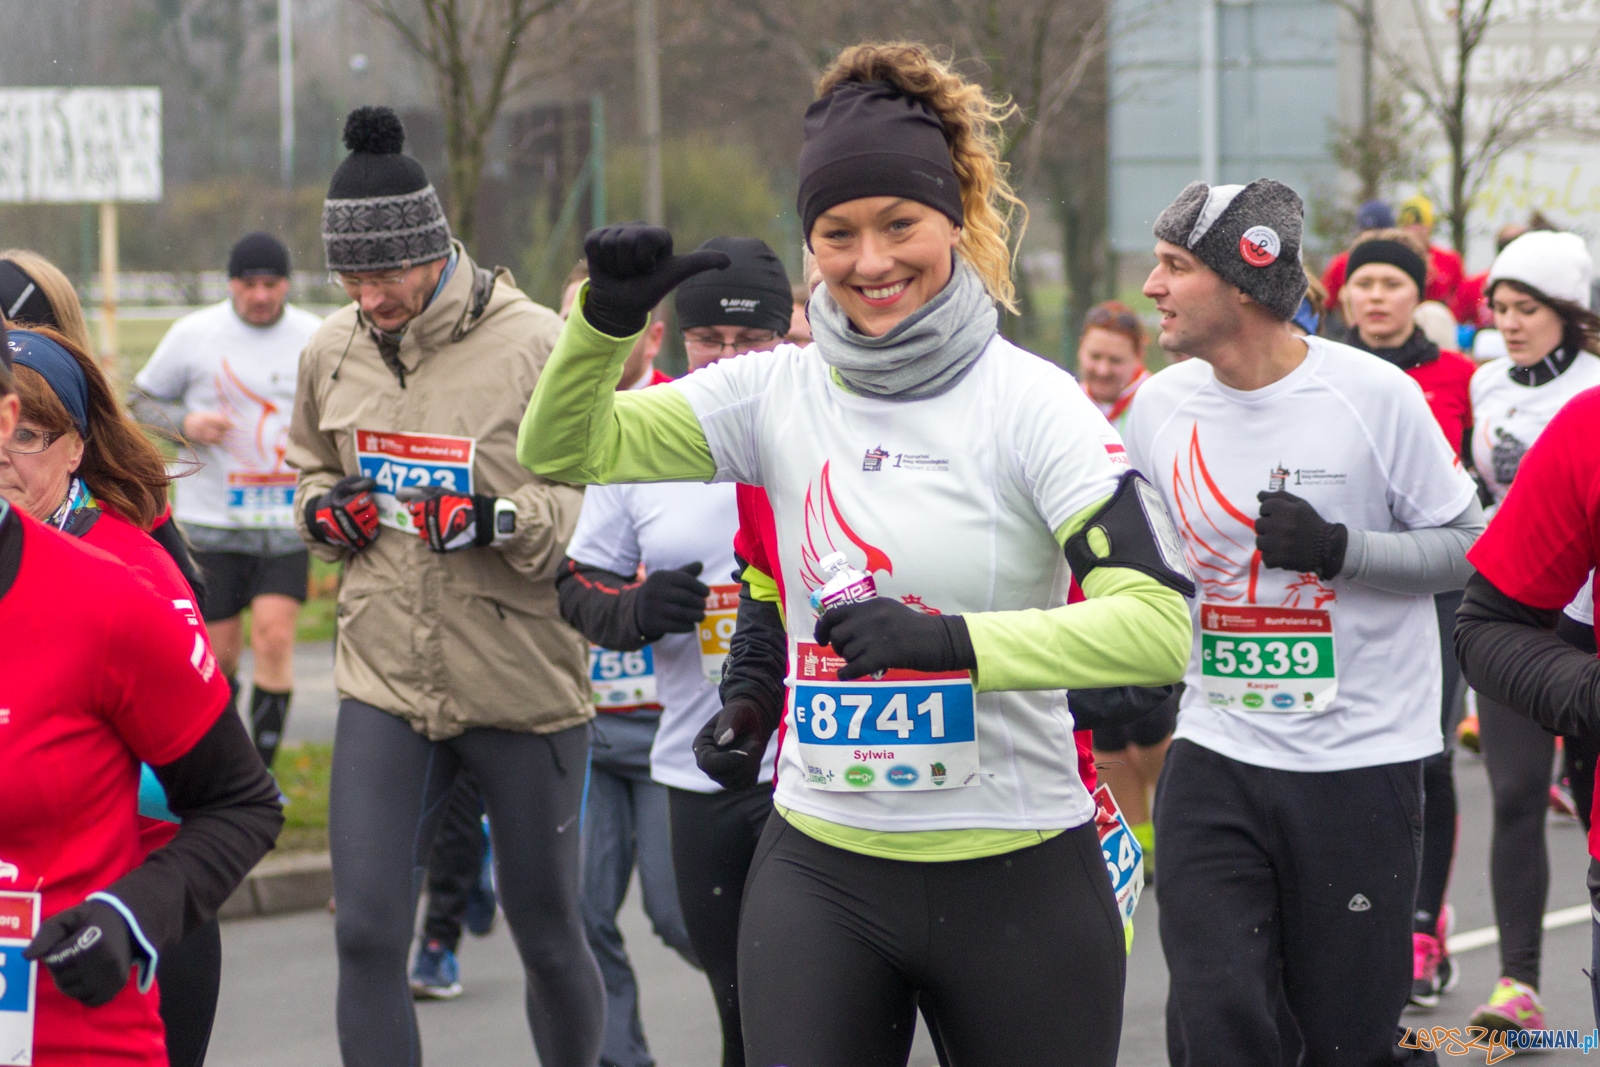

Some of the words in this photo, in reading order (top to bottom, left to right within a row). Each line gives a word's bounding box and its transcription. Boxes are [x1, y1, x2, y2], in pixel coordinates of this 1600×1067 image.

[375, 461, 458, 492] 4723
[1264, 617, 1324, 627] RunPoland.org
[1215, 640, 1319, 676] 5339
[1246, 682, 1279, 690] Kacper
[796, 707, 806, 722] E
[811, 692, 945, 740] 8741
[853, 750, 895, 762] Sylwia
